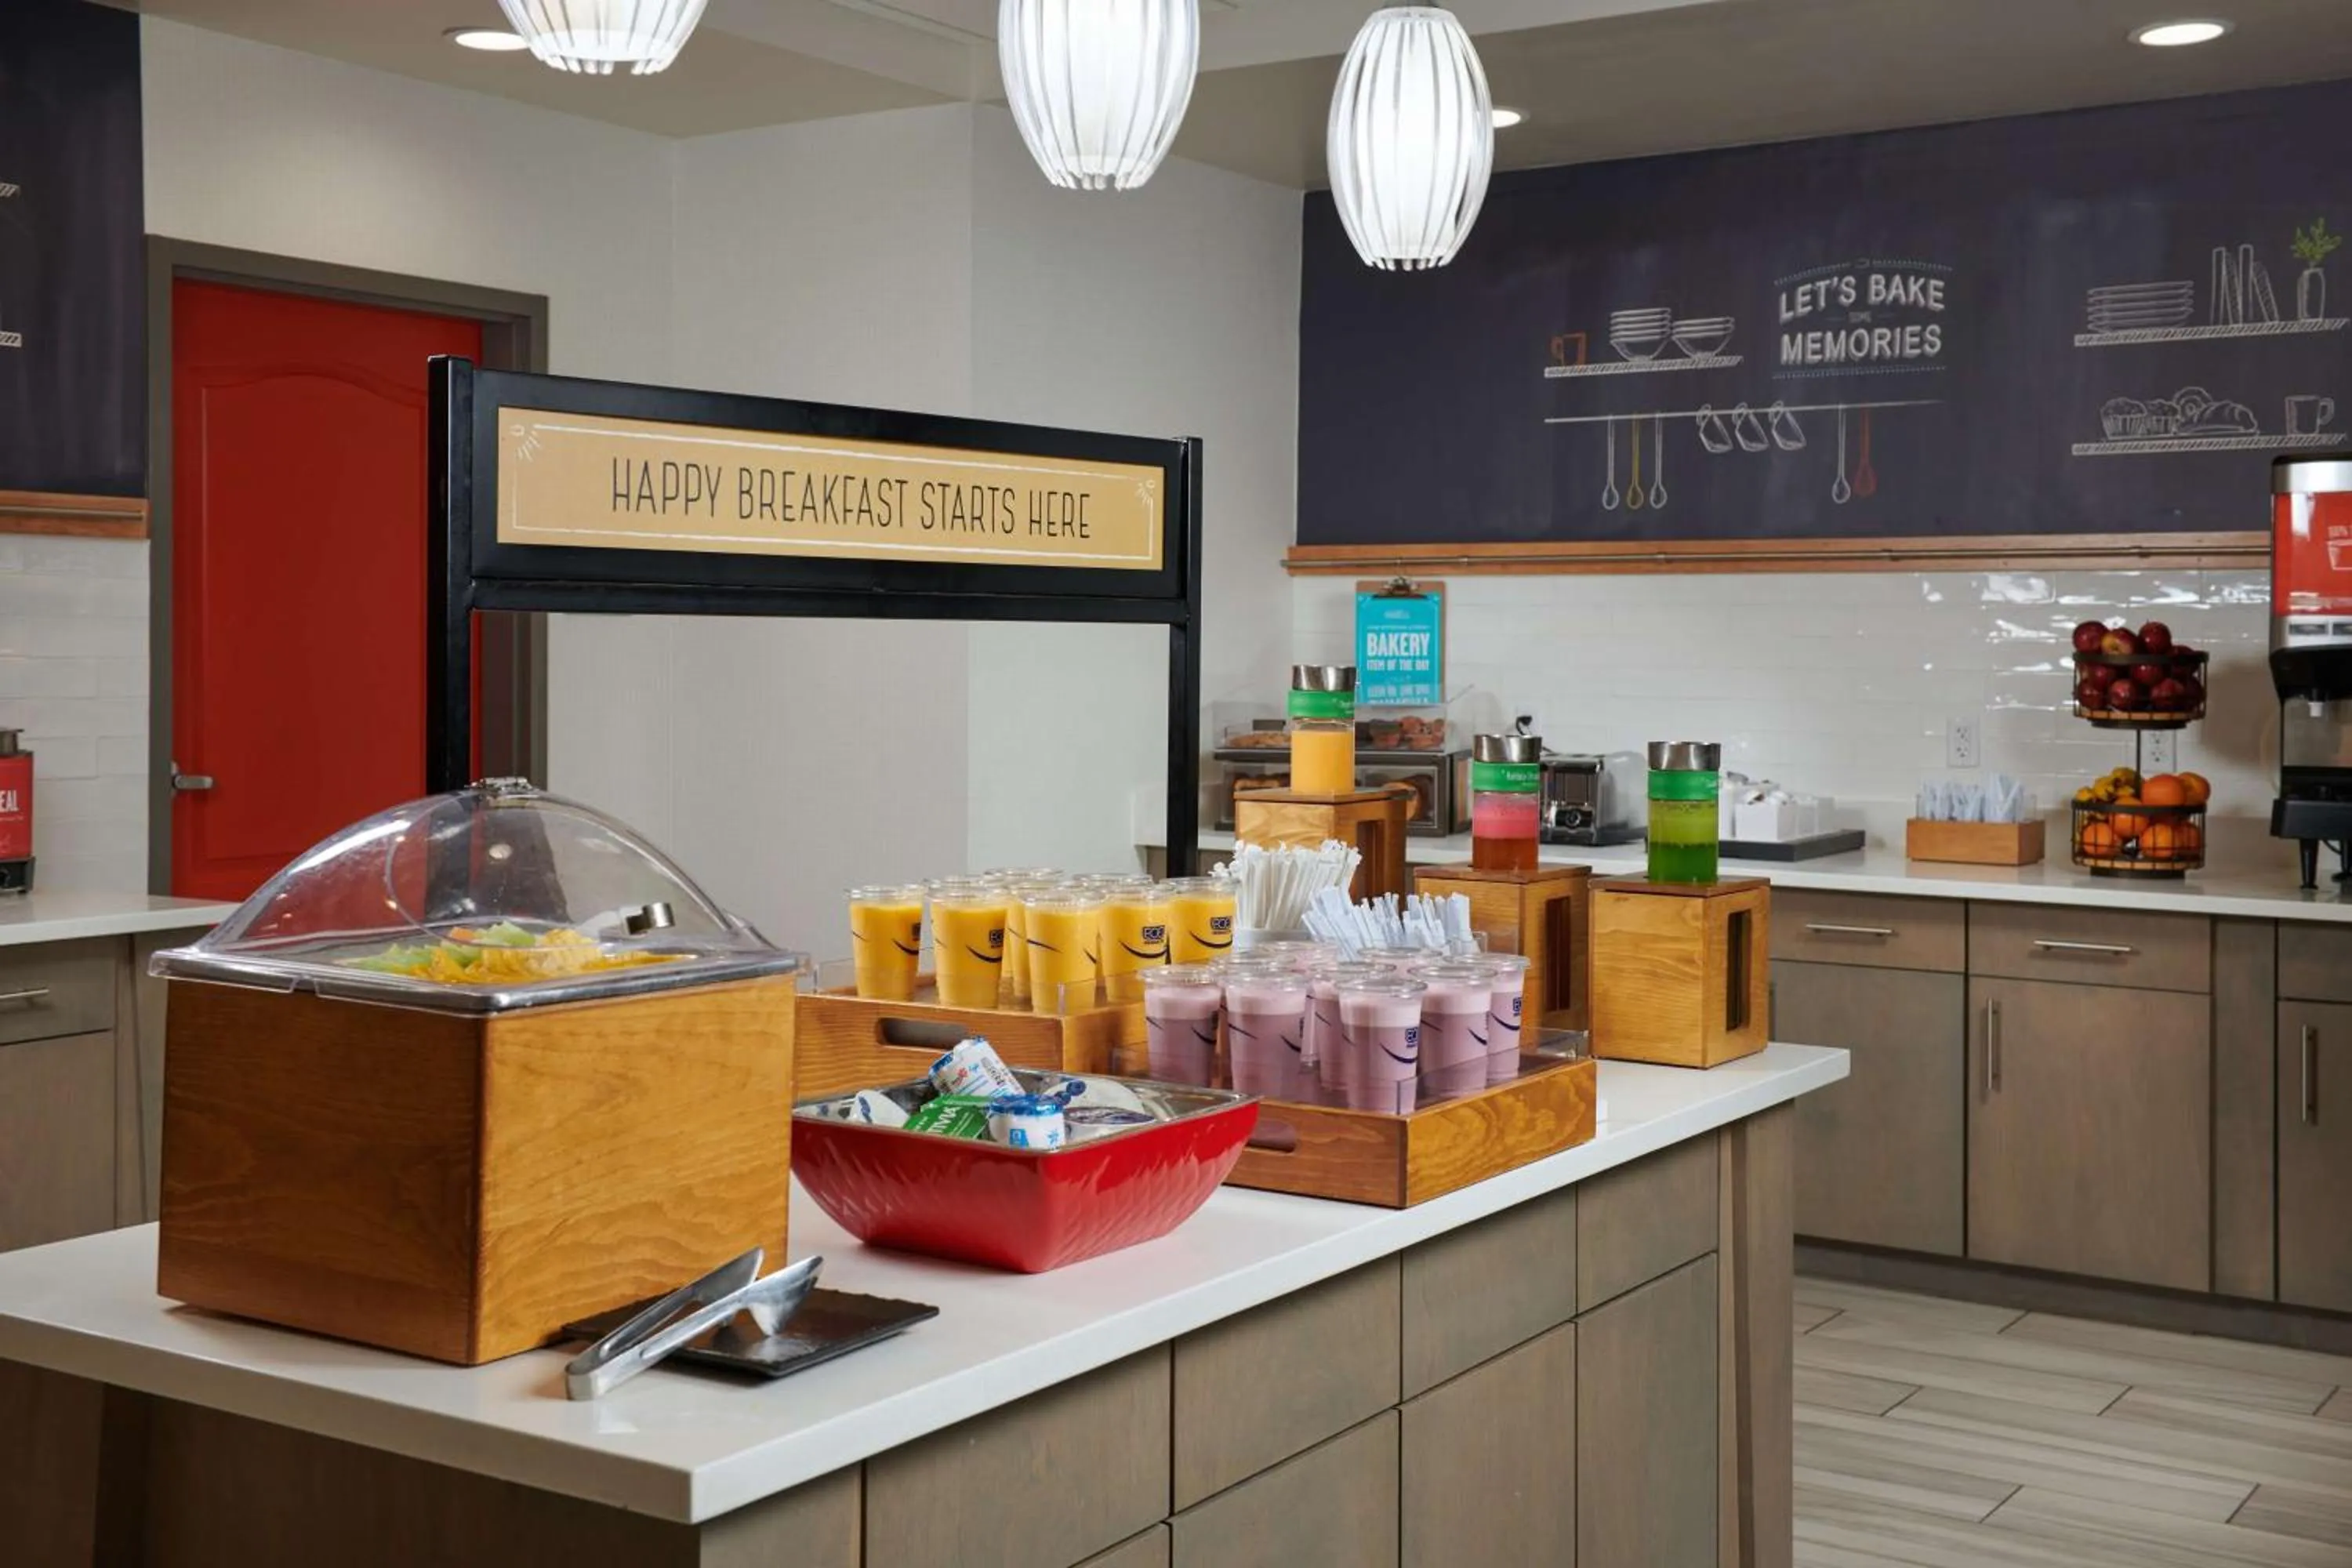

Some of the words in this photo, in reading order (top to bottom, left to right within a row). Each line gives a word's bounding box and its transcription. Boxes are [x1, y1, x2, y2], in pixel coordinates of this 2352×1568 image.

[1779, 276, 1857, 324] LET'S
[1867, 274, 1945, 311] BAKE
[1780, 324, 1943, 365] MEMORIES
[612, 457, 722, 517] HAPPY
[739, 467, 909, 528] BREAKFAST
[920, 481, 1016, 534] STARTS
[1029, 490, 1091, 539] HERE
[1367, 632, 1431, 656] BAKERY
